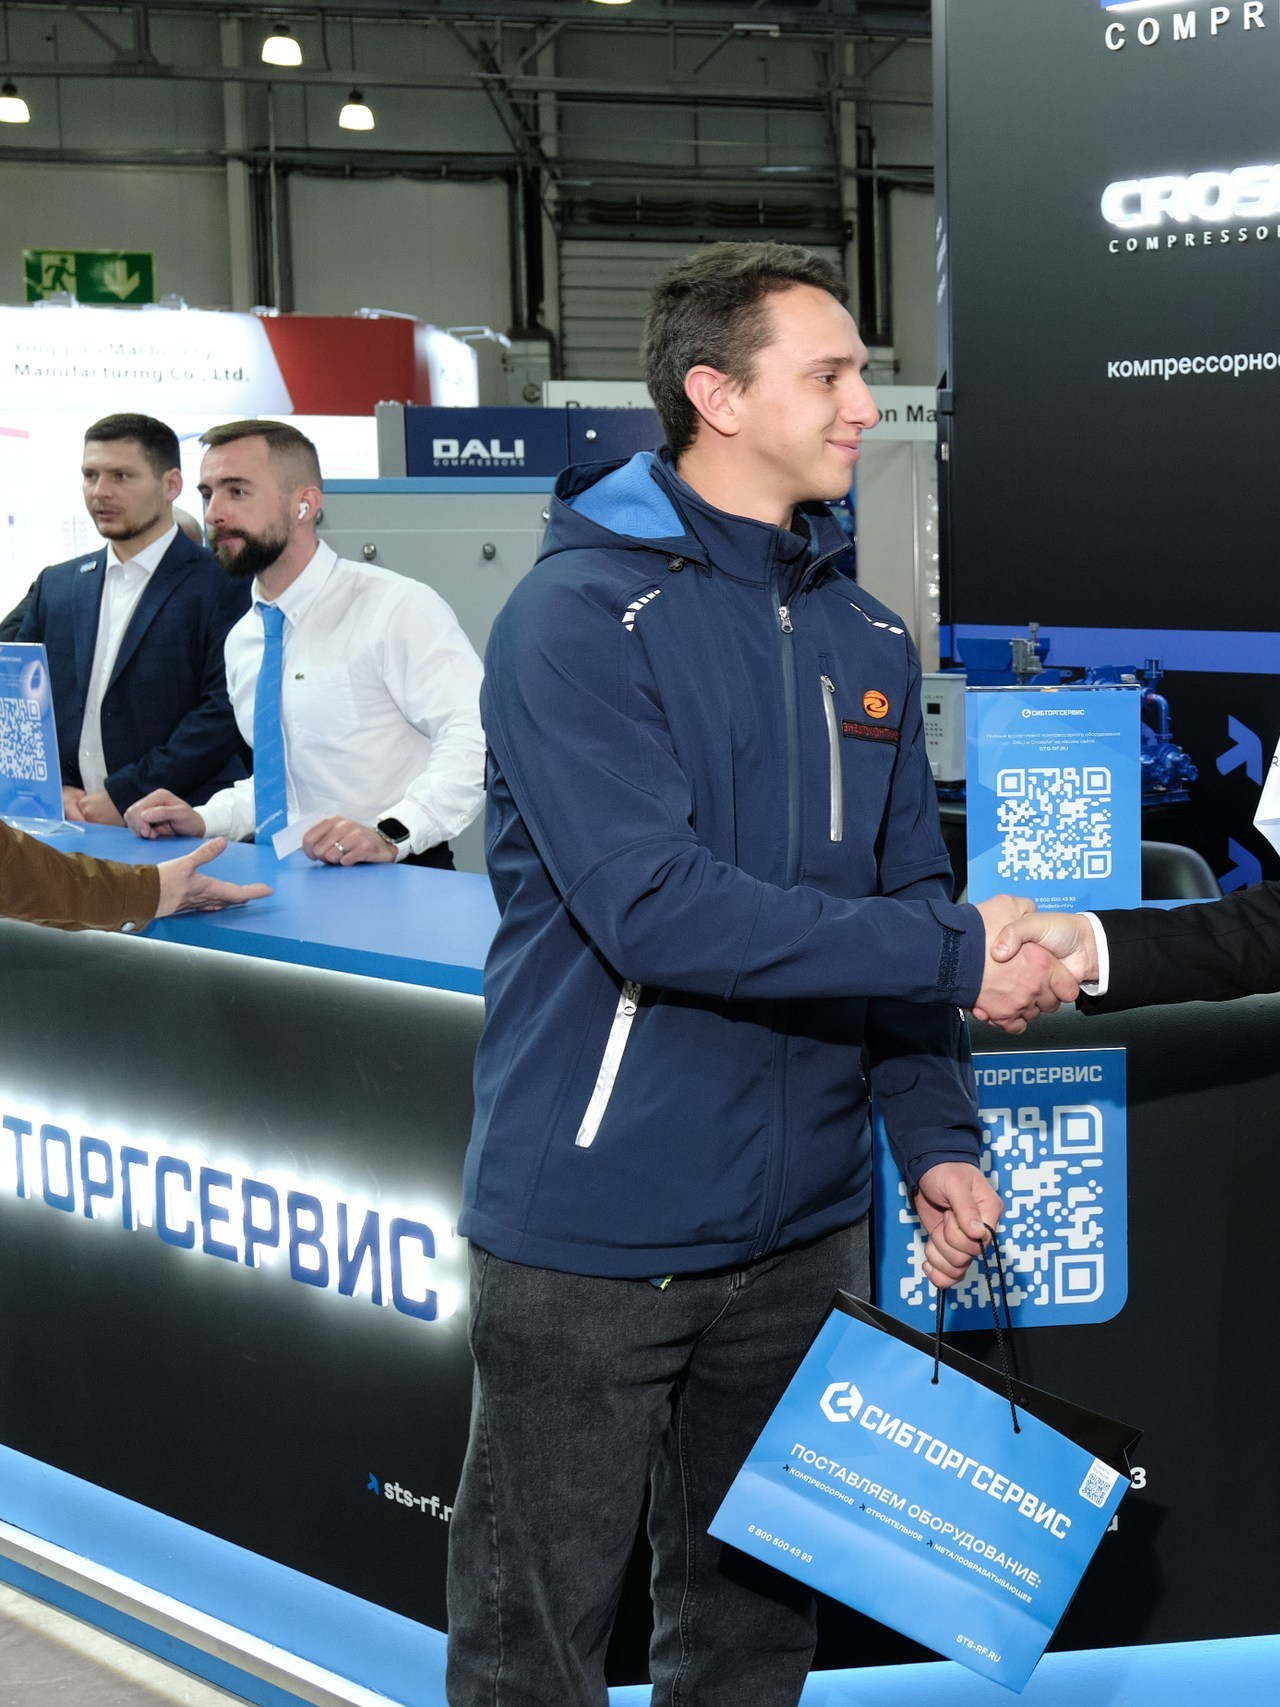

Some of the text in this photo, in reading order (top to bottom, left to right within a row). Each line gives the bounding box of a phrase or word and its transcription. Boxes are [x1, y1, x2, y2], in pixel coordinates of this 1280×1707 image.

[14, 362, 163, 383] Manufacturing
[432, 438, 525, 459] DALI
[432, 459, 525, 467] COMPRESSORS
[2, 1114, 442, 1323] ТОРГСЕРВИС
[859, 1404, 1072, 1540] СИБТОРГСЕРВИС
[789, 1467, 855, 1506] КОМПРЕССОРНОЕ
[865, 1507, 924, 1542] СТРОИТЕЛЬНОЕ
[789, 1442, 1043, 1589] ПОСТАВЛЯЕМ ОБОРУДОВАНИЕ:
[748, 1524, 813, 1563] 8 800 500 43 93
[956, 1634, 1002, 1663] STS-RF.RU
